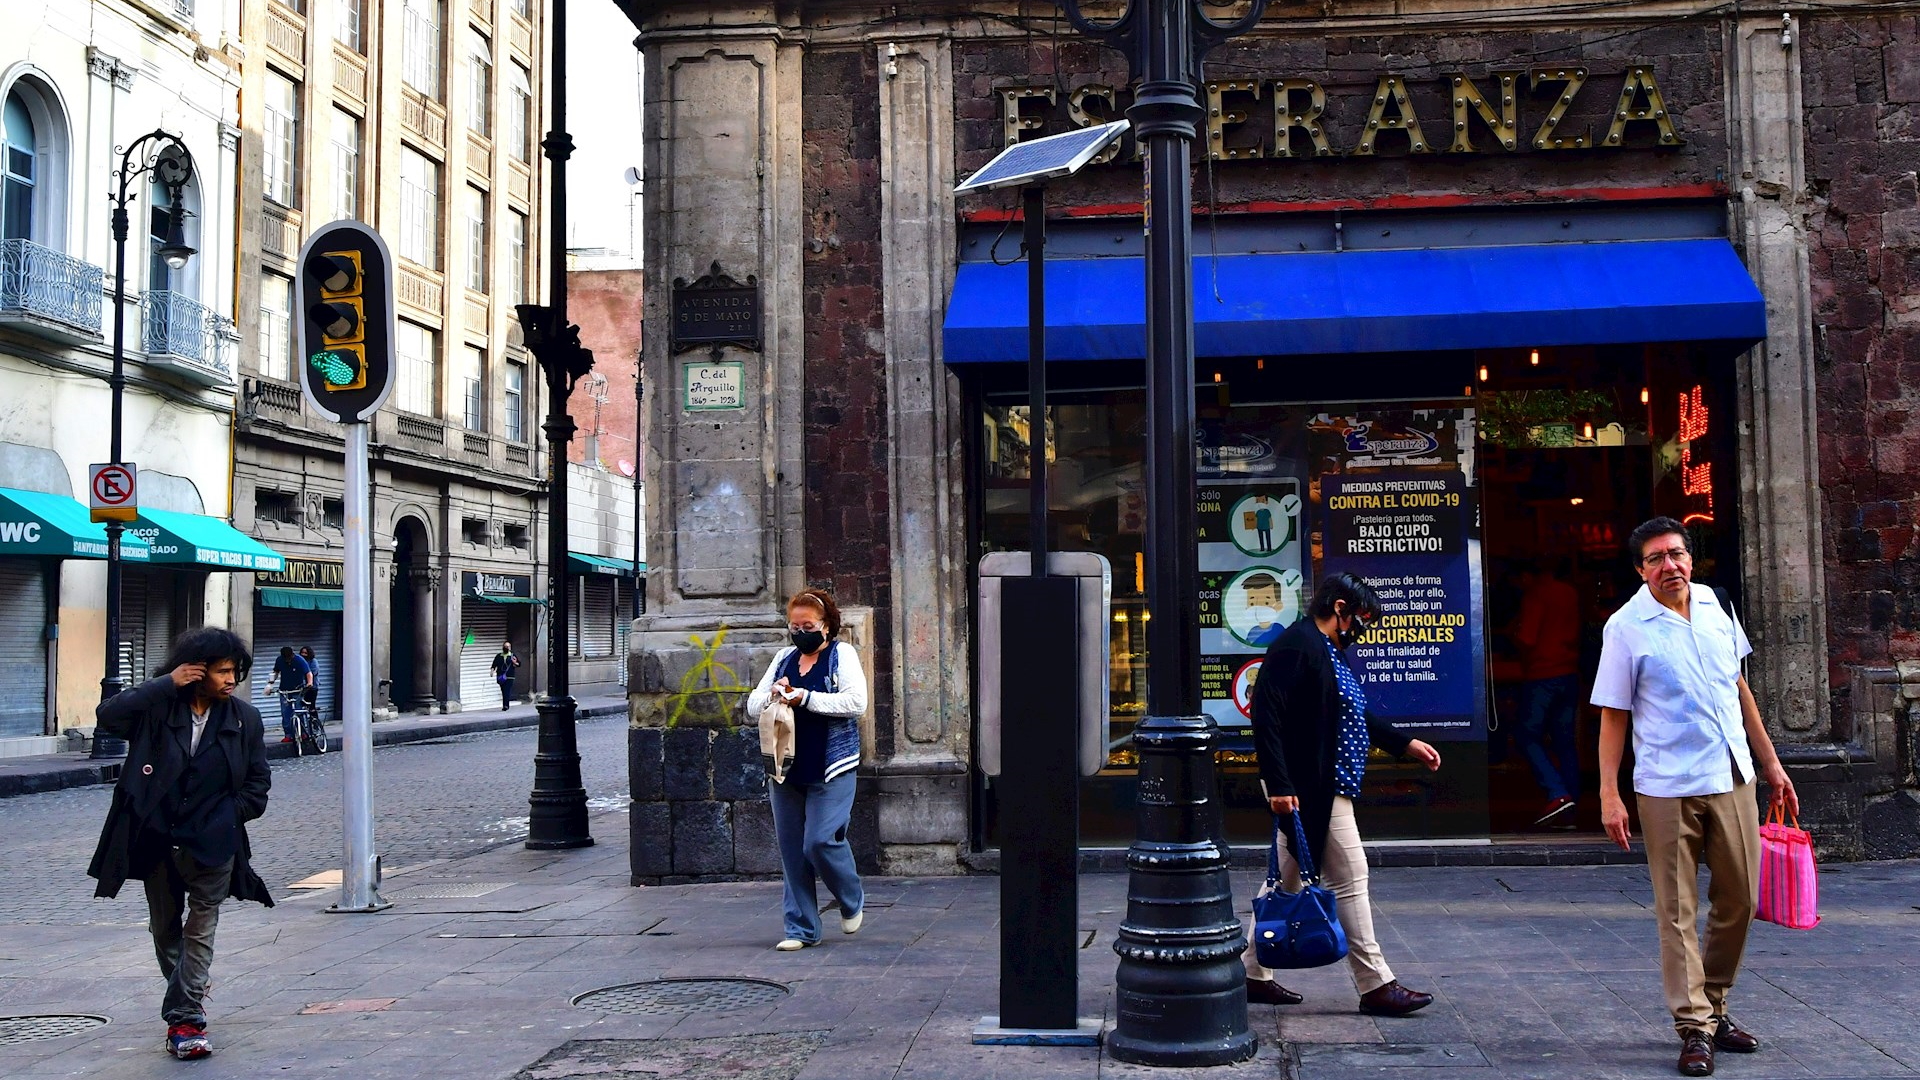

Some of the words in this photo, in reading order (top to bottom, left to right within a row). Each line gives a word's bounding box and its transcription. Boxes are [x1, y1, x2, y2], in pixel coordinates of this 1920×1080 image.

[992, 64, 1687, 164] ESERANZA
[681, 298, 751, 308] AVENIDA
[681, 312, 688, 322] 5
[694, 312, 709, 322] DE
[715, 312, 751, 322] MAYO
[700, 369, 711, 379] C.
[713, 370, 727, 379] del
[690, 382, 735, 395] Arguillo
[1344, 424, 1427, 454] Esperanza
[1342, 482, 1383, 493] MEDIDAS
[1385, 480, 1446, 491] PREVENTIVAS
[1201, 490, 1221, 500] sólo
[1329, 495, 1381, 510] CONTRA
[1384, 494, 1398, 508] EL
[1401, 493, 1460, 507] COVID-19
[1353, 514, 1392, 525] ¡Pastelería
[1394, 515, 1411, 524] para
[0, 522, 41, 542] WC
[127, 528, 160, 537] TACOS
[1359, 525, 1391, 538] BAJO
[1395, 524, 1430, 537] CUPO
[142, 537, 155, 545] DE
[1347, 537, 1443, 553] RESTRICTIVO!
[196, 548, 219, 562] SUPER
[220, 552, 242, 565] TACOS
[243, 554, 252, 567] DE
[255, 556, 281, 570] GUISADO
[320, 563, 344, 585] MUND
[1403, 576, 1414, 585] de
[1416, 575, 1441, 585] forma
[1409, 589, 1425, 600] por
[1427, 587, 1447, 598] ello,
[1410, 600, 1428, 612] bajo
[1430, 602, 1442, 610] un
[1382, 614, 1465, 628] CONTROLADO
[1356, 627, 1455, 644] SUCURSALES
[1357, 648, 1374, 657] con
[1377, 647, 1385, 657] la
[1387, 646, 1426, 656] finalidad
[1428, 645, 1440, 655] de
[1366, 660, 1394, 670] cuidar
[1396, 660, 1405, 669] tu
[1408, 659, 1432, 669] salud
[1360, 674, 1366, 684] y
[1368, 672, 1377, 682] la
[1379, 672, 1391, 682] de
[1393, 672, 1402, 682] tu
[1405, 671, 1438, 681] familia.
[1211, 690, 1227, 698] AÑOS
